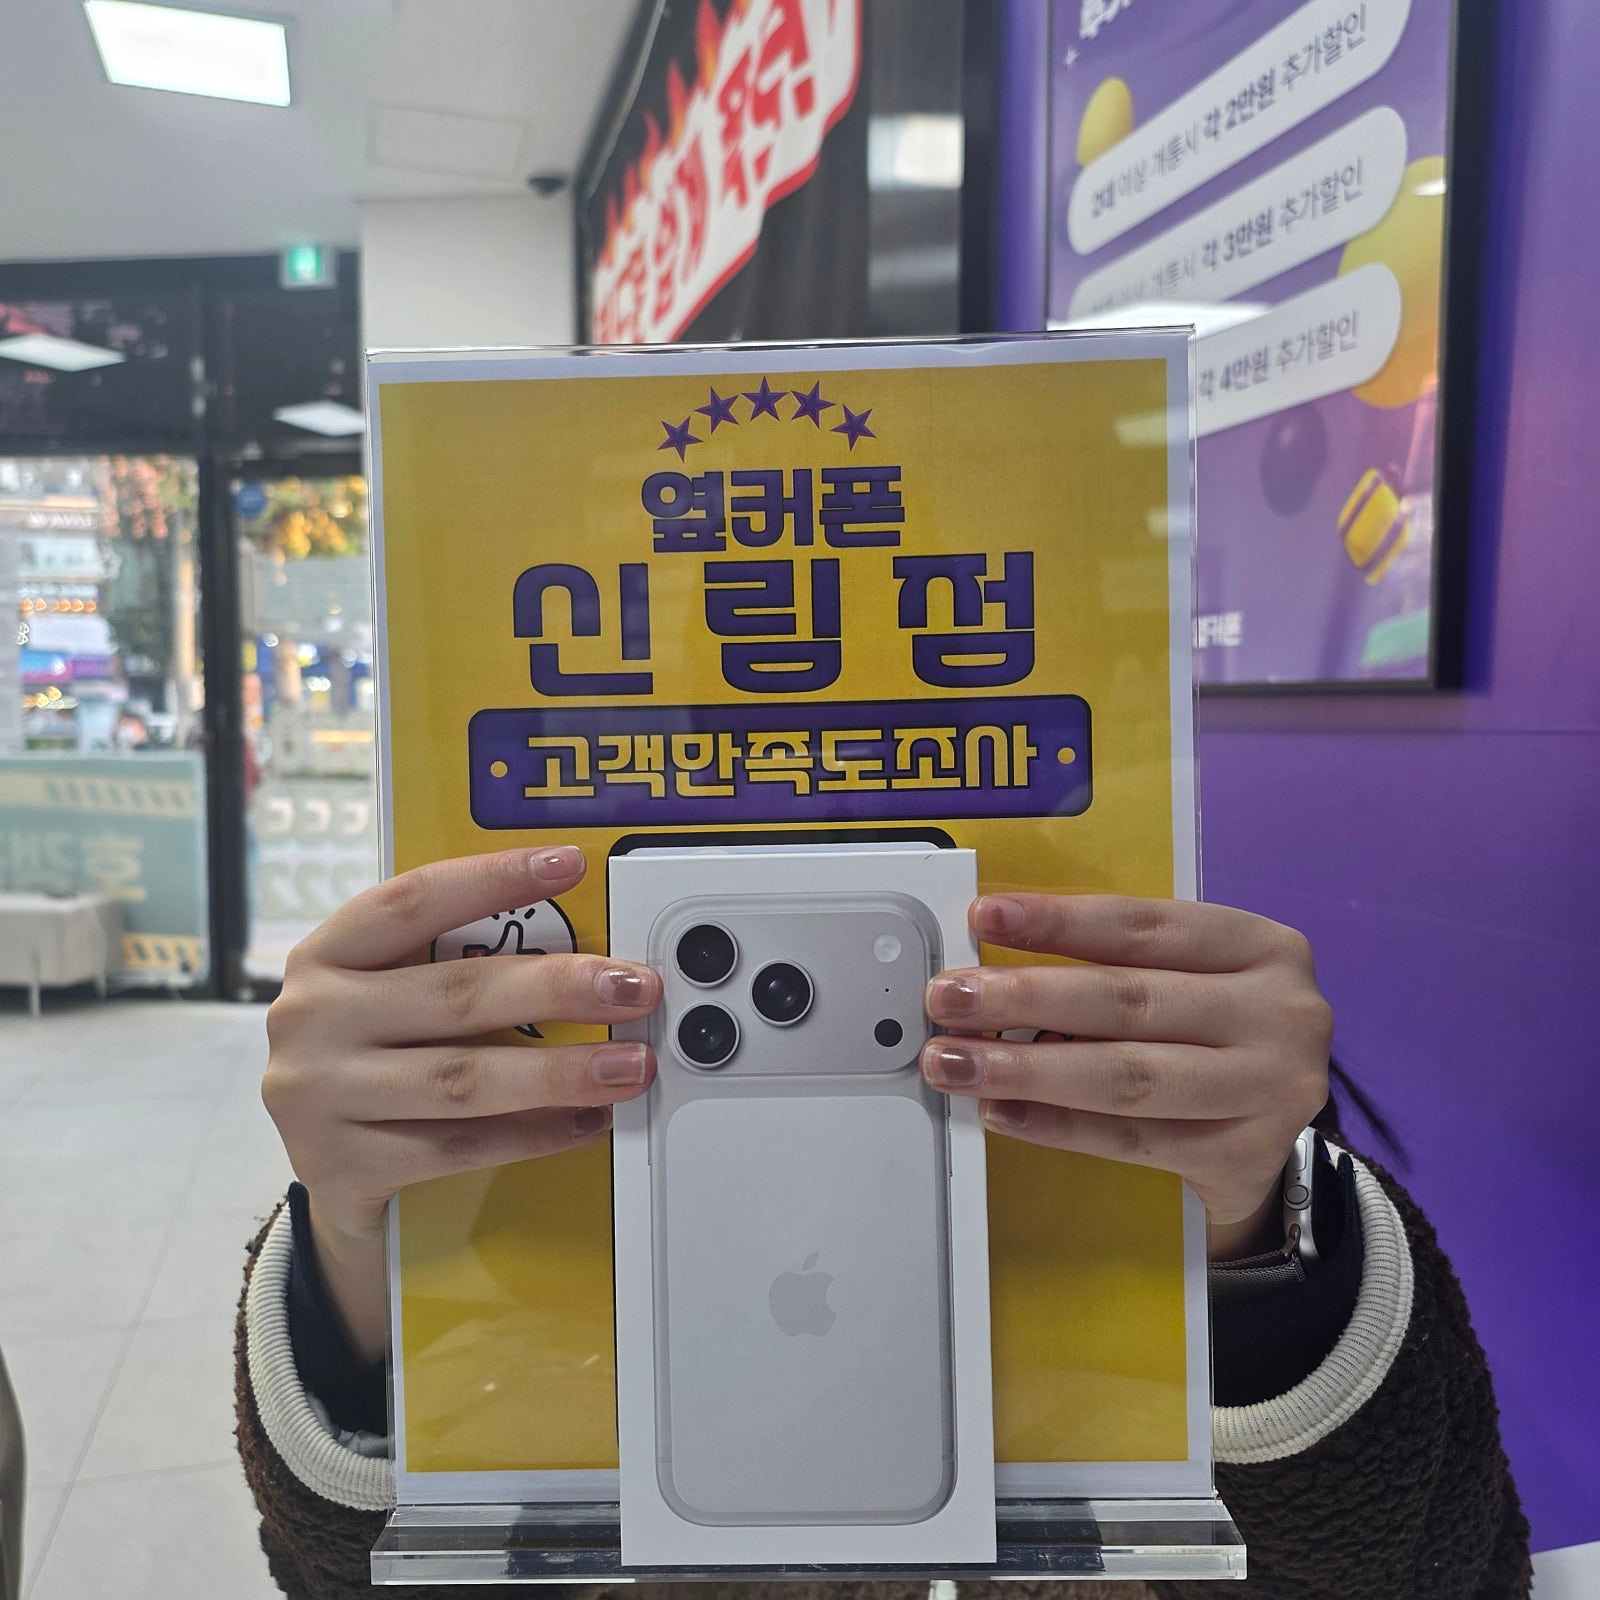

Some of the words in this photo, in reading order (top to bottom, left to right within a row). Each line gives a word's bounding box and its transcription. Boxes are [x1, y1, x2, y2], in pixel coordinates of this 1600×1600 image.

[1202, 107, 1222, 143] 각
[1225, 67, 1276, 131] 2만원
[1280, 2, 1367, 92] 추가할인
[1201, 238, 1219, 271] 각
[1222, 206, 1273, 262] 3만원
[1279, 156, 1363, 233] 추가할인
[1219, 344, 1270, 391] 4만원
[1275, 309, 1359, 373] 추가할인
[641, 465, 906, 554] 옆커폰
[512, 550, 1036, 697] 신림점
[523, 723, 1039, 800] 고객만족도조사
